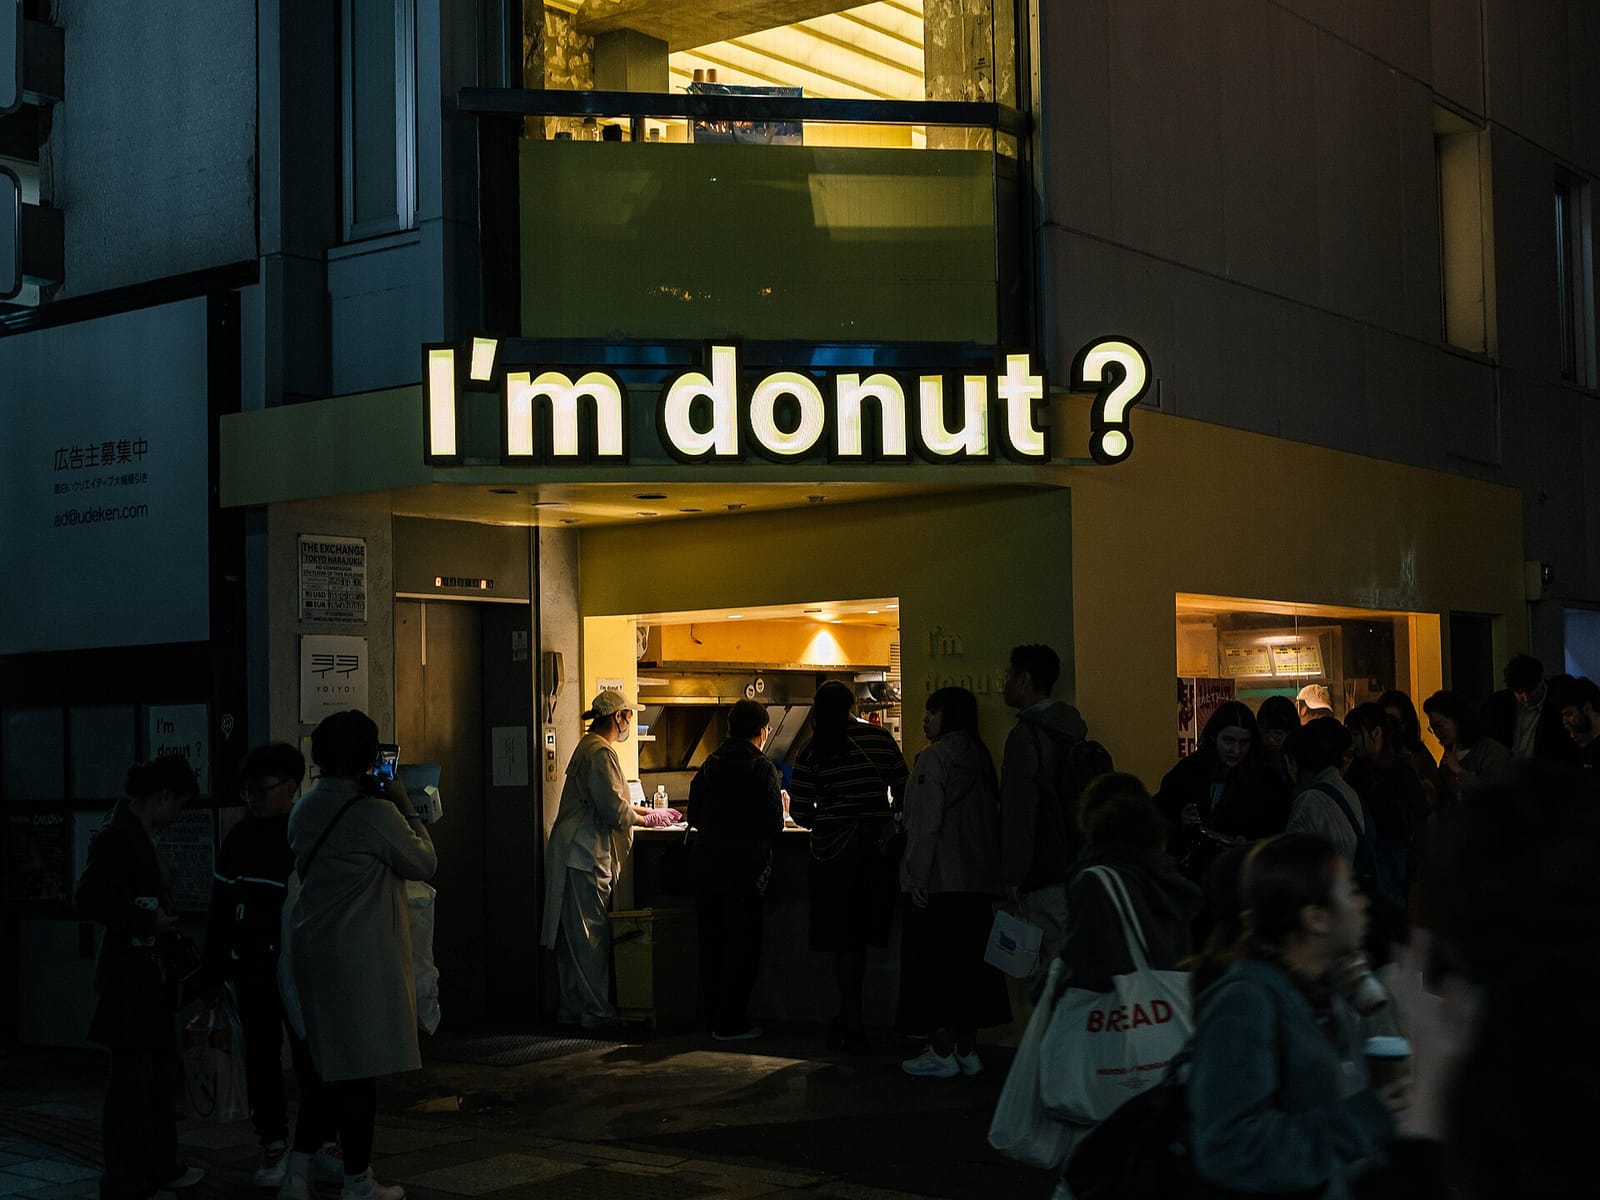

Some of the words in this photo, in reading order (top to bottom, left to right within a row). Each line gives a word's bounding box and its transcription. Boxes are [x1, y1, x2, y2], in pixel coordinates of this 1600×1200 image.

[427, 336, 625, 457] I'm
[664, 345, 1046, 457] donut
[1080, 341, 1151, 458] ?
[54, 437, 148, 472] 広告主募集中
[54, 504, 148, 527] ad@udeken.com
[303, 543, 319, 553] THE
[320, 544, 365, 557] EXCHANGE
[304, 554, 327, 563] TOKYO
[328, 556, 363, 566] HARAJUKU
[156, 717, 174, 734] I'm
[1086, 999, 1173, 1034] BREAD
